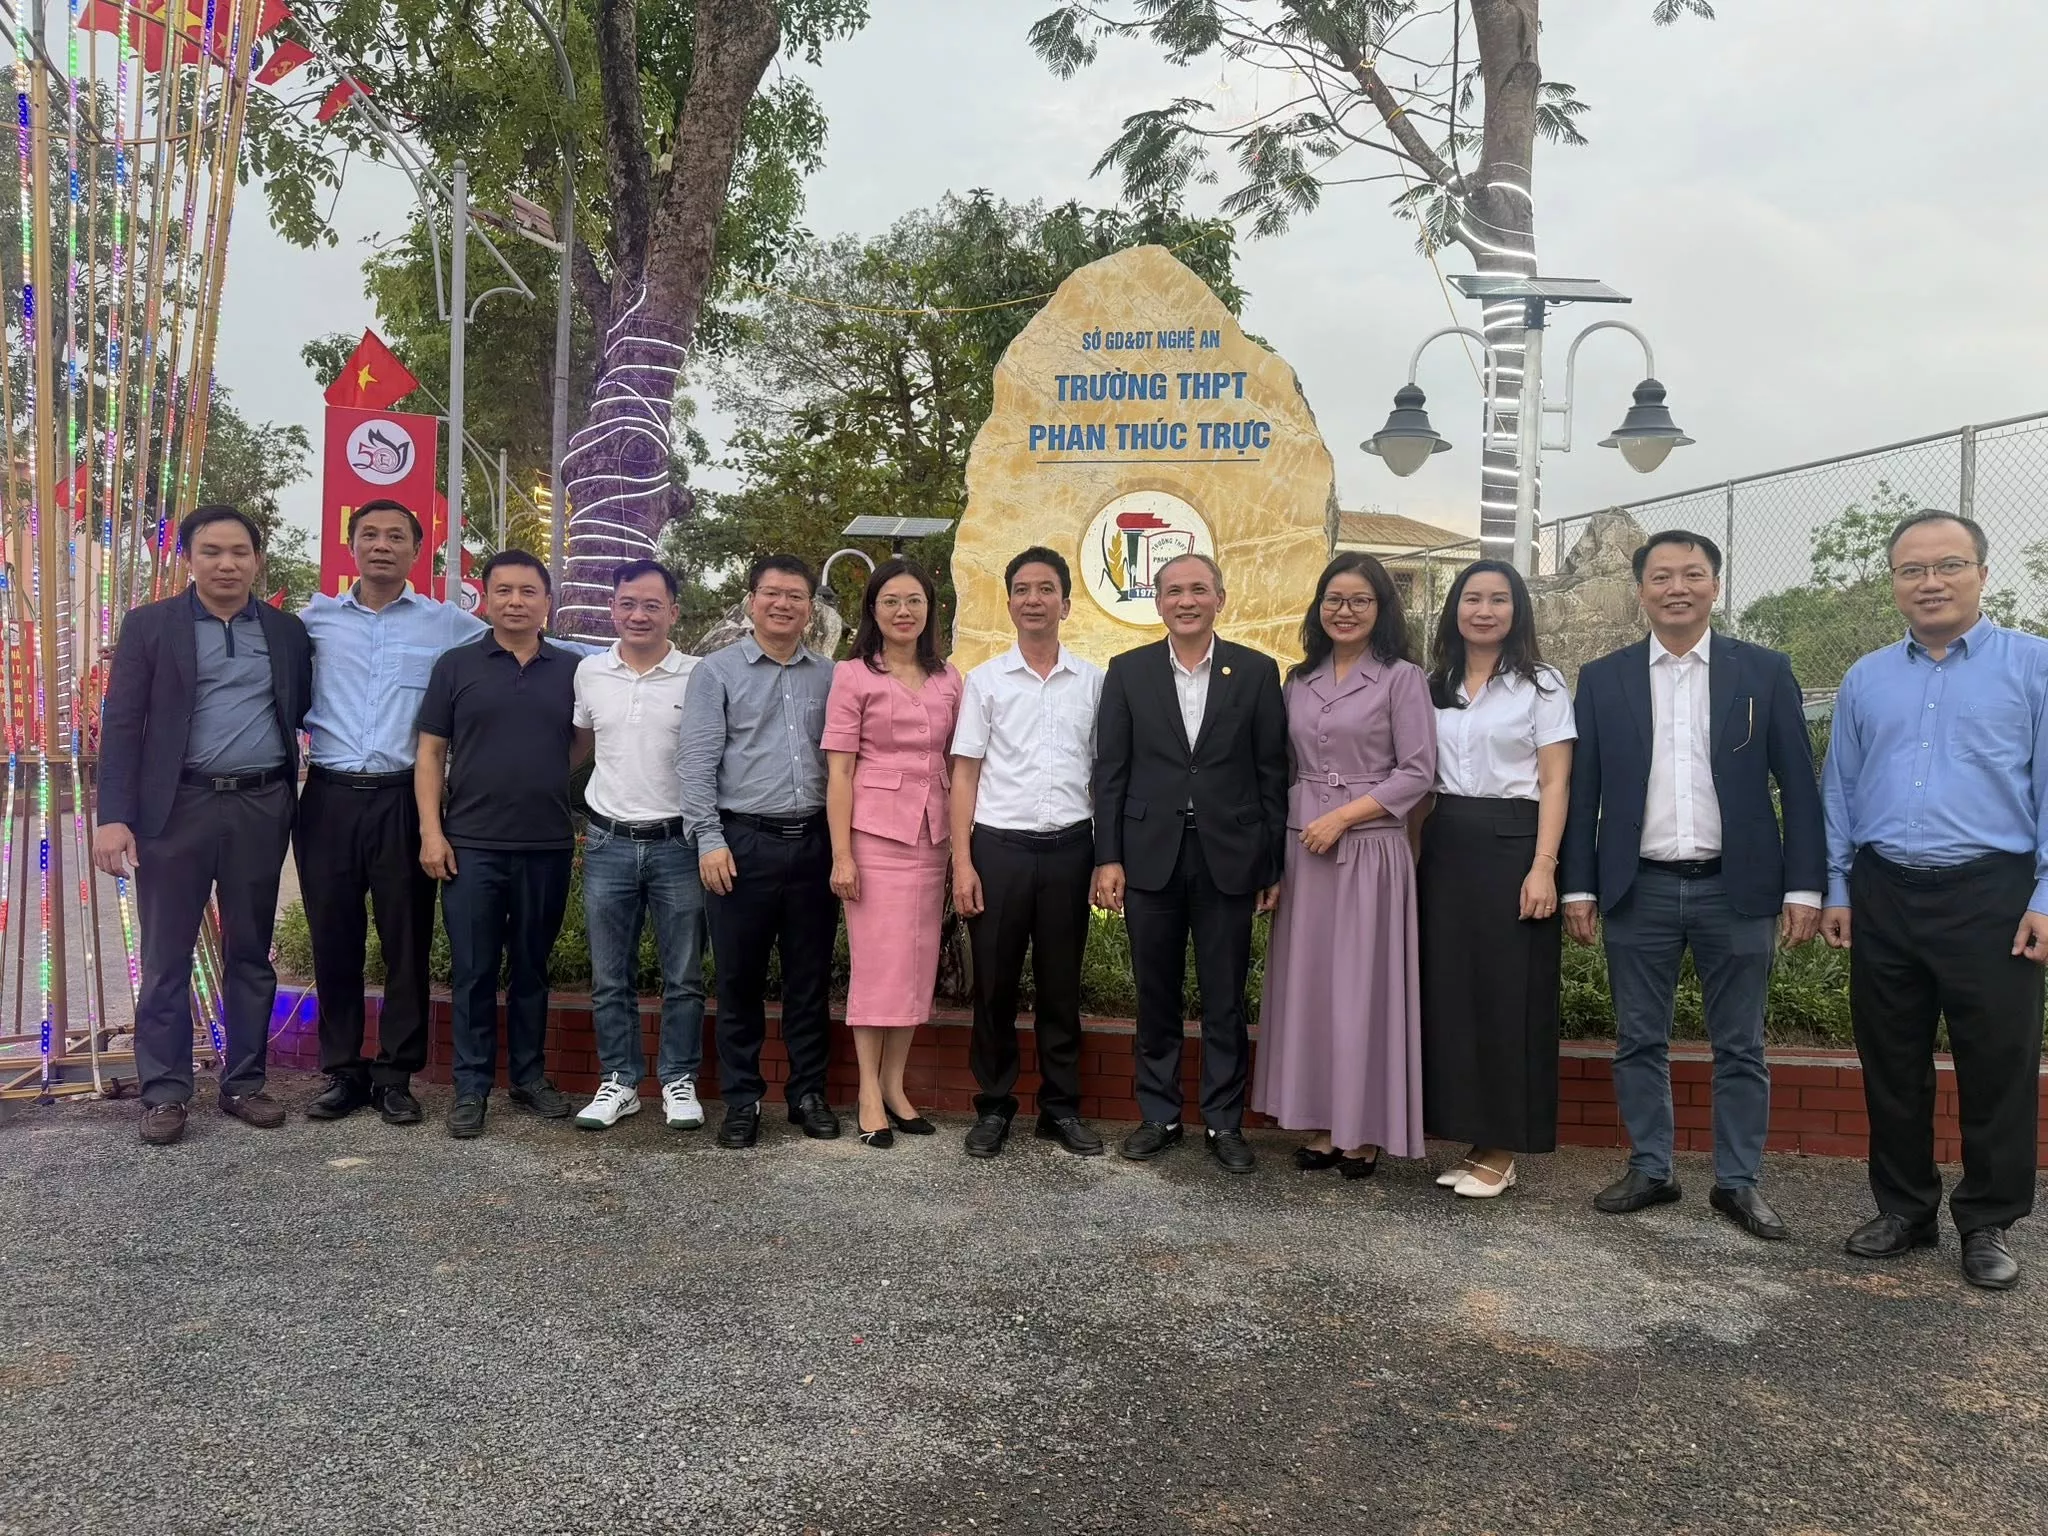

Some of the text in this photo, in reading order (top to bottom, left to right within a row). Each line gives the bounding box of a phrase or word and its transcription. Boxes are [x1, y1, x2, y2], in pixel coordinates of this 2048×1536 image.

[1082, 326, 1221, 353] SỞ GD&ĐT NGHỆ AN
[1055, 368, 1248, 402] TRƯỜNG THPT
[1029, 418, 1272, 455] PHAN THÚC TRỰC
